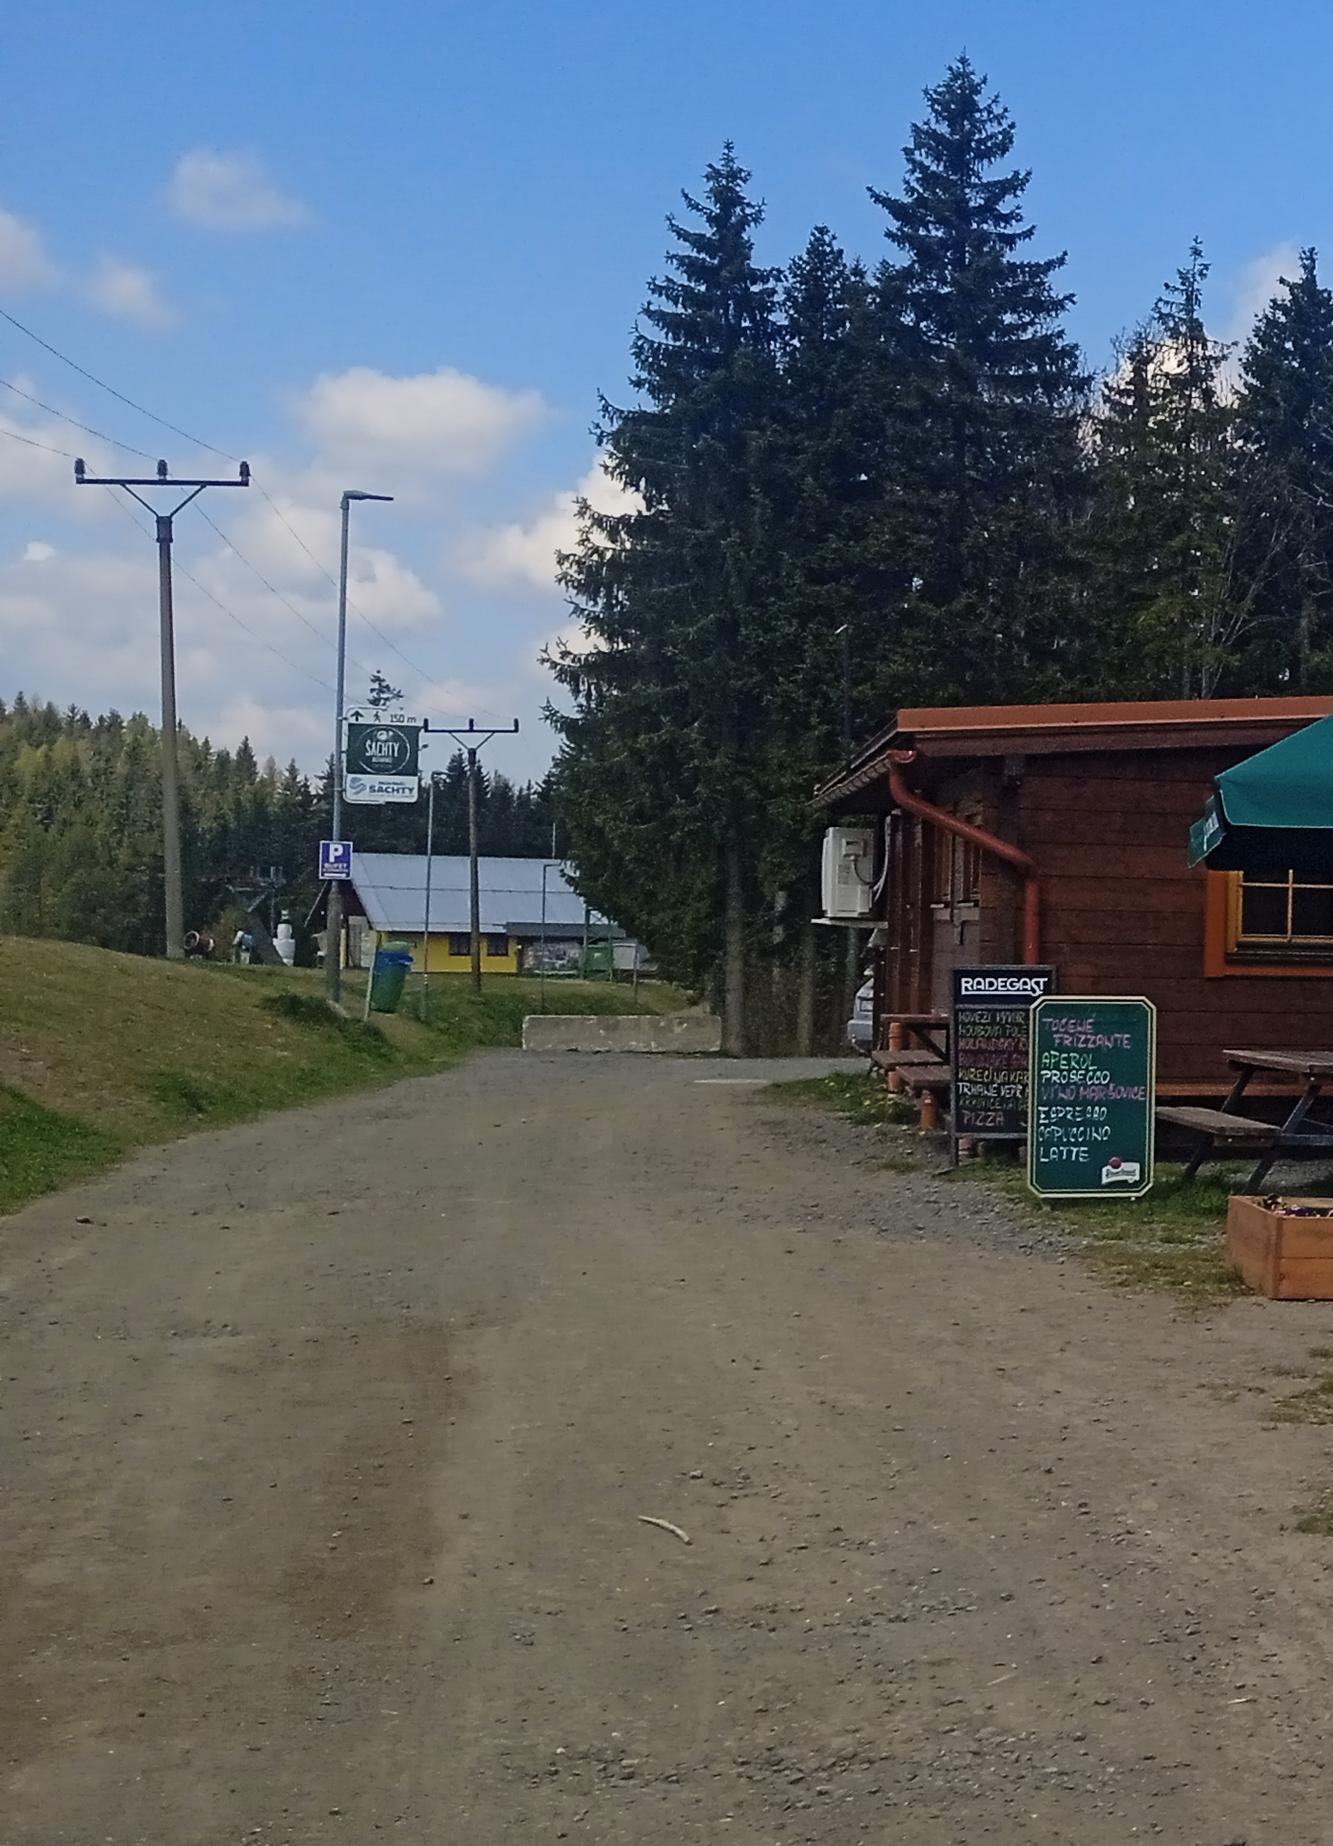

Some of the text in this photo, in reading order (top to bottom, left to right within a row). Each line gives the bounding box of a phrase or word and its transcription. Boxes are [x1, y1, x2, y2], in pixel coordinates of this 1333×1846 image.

[390, 714, 405, 723] 150
[329, 844, 343, 863] P
[961, 978, 1048, 996] RADEGAST
[1053, 1034, 1131, 1049] FRIZZANTE
[1041, 1050, 1098, 1070] APEROL
[1040, 1070, 1110, 1085] PROSECCO
[962, 1110, 1004, 1127] PIZZA
[1040, 1146, 1089, 1162] LATTE
